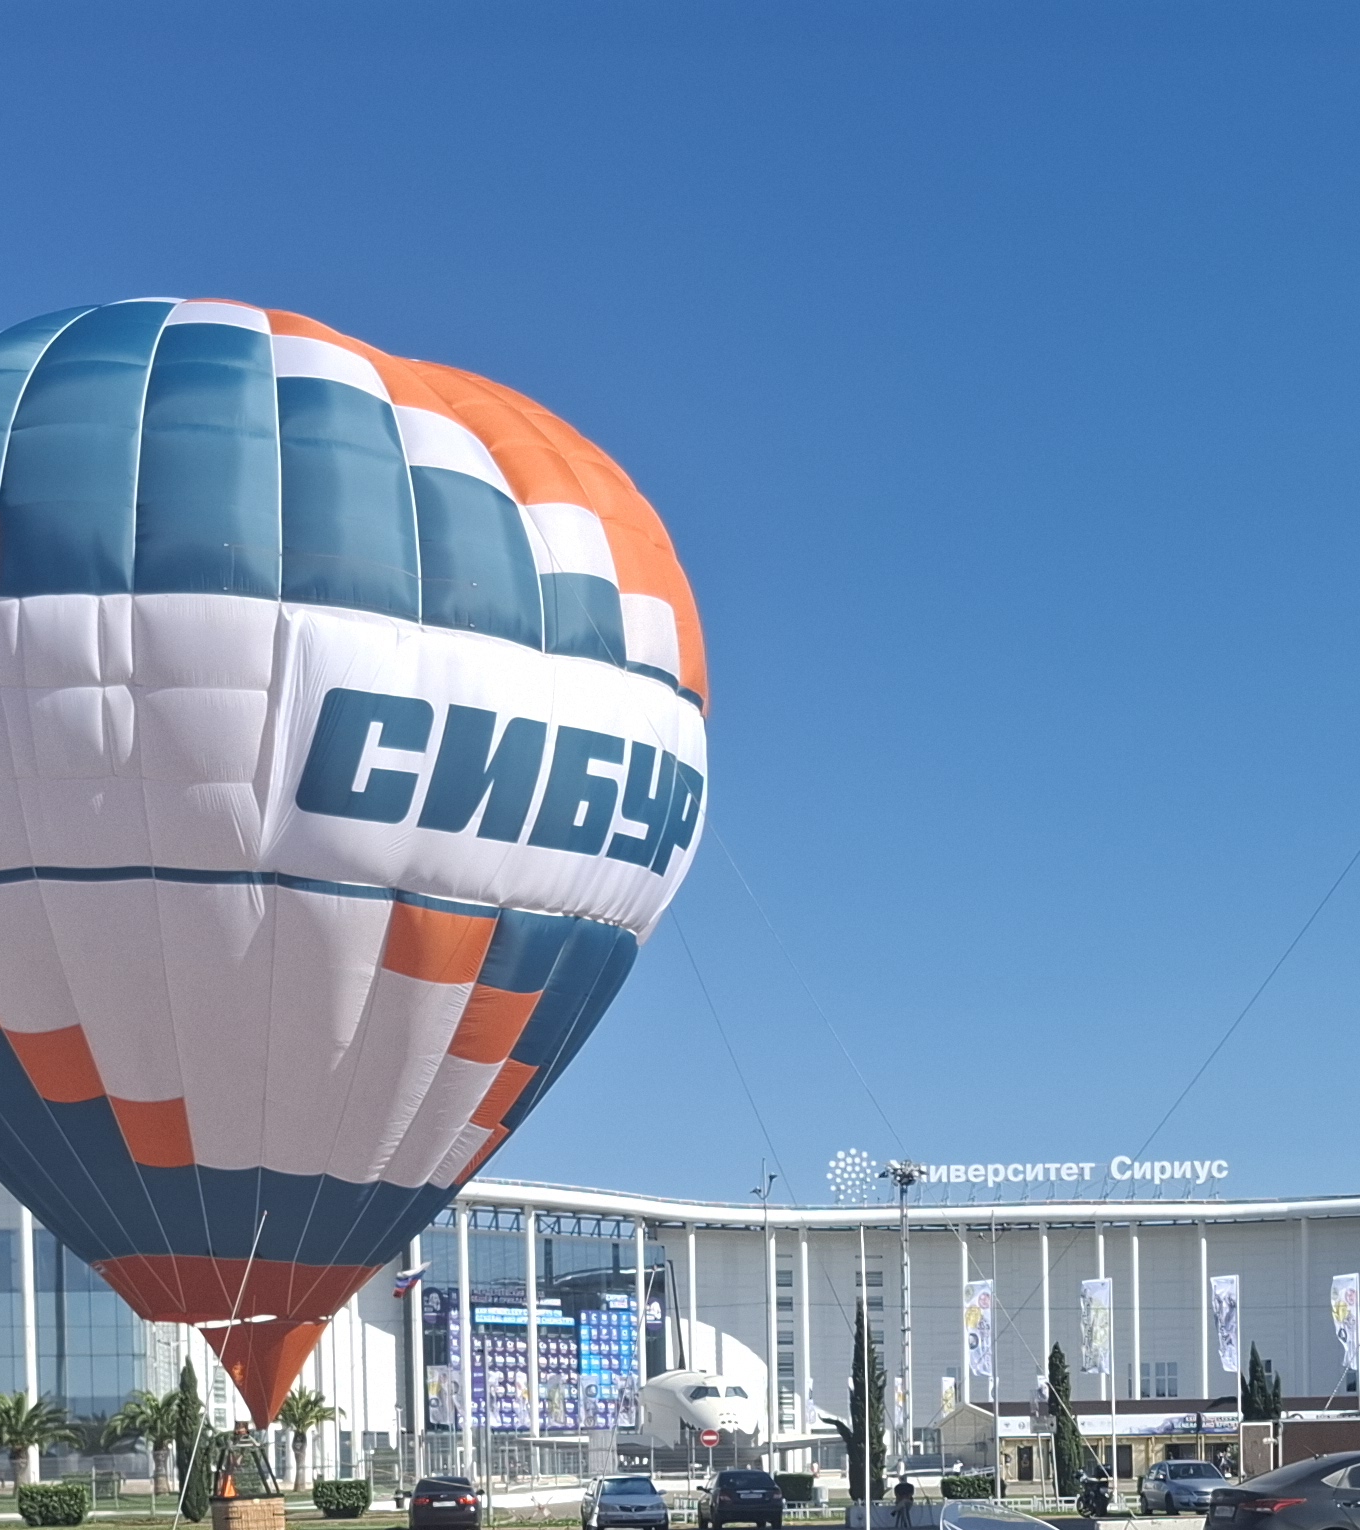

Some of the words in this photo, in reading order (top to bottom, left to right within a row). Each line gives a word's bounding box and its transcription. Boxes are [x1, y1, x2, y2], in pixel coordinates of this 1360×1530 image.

[295, 686, 705, 877] СИБУР
[890, 1160, 1095, 1188] иверситет
[1110, 1154, 1229, 1185] Сириус
